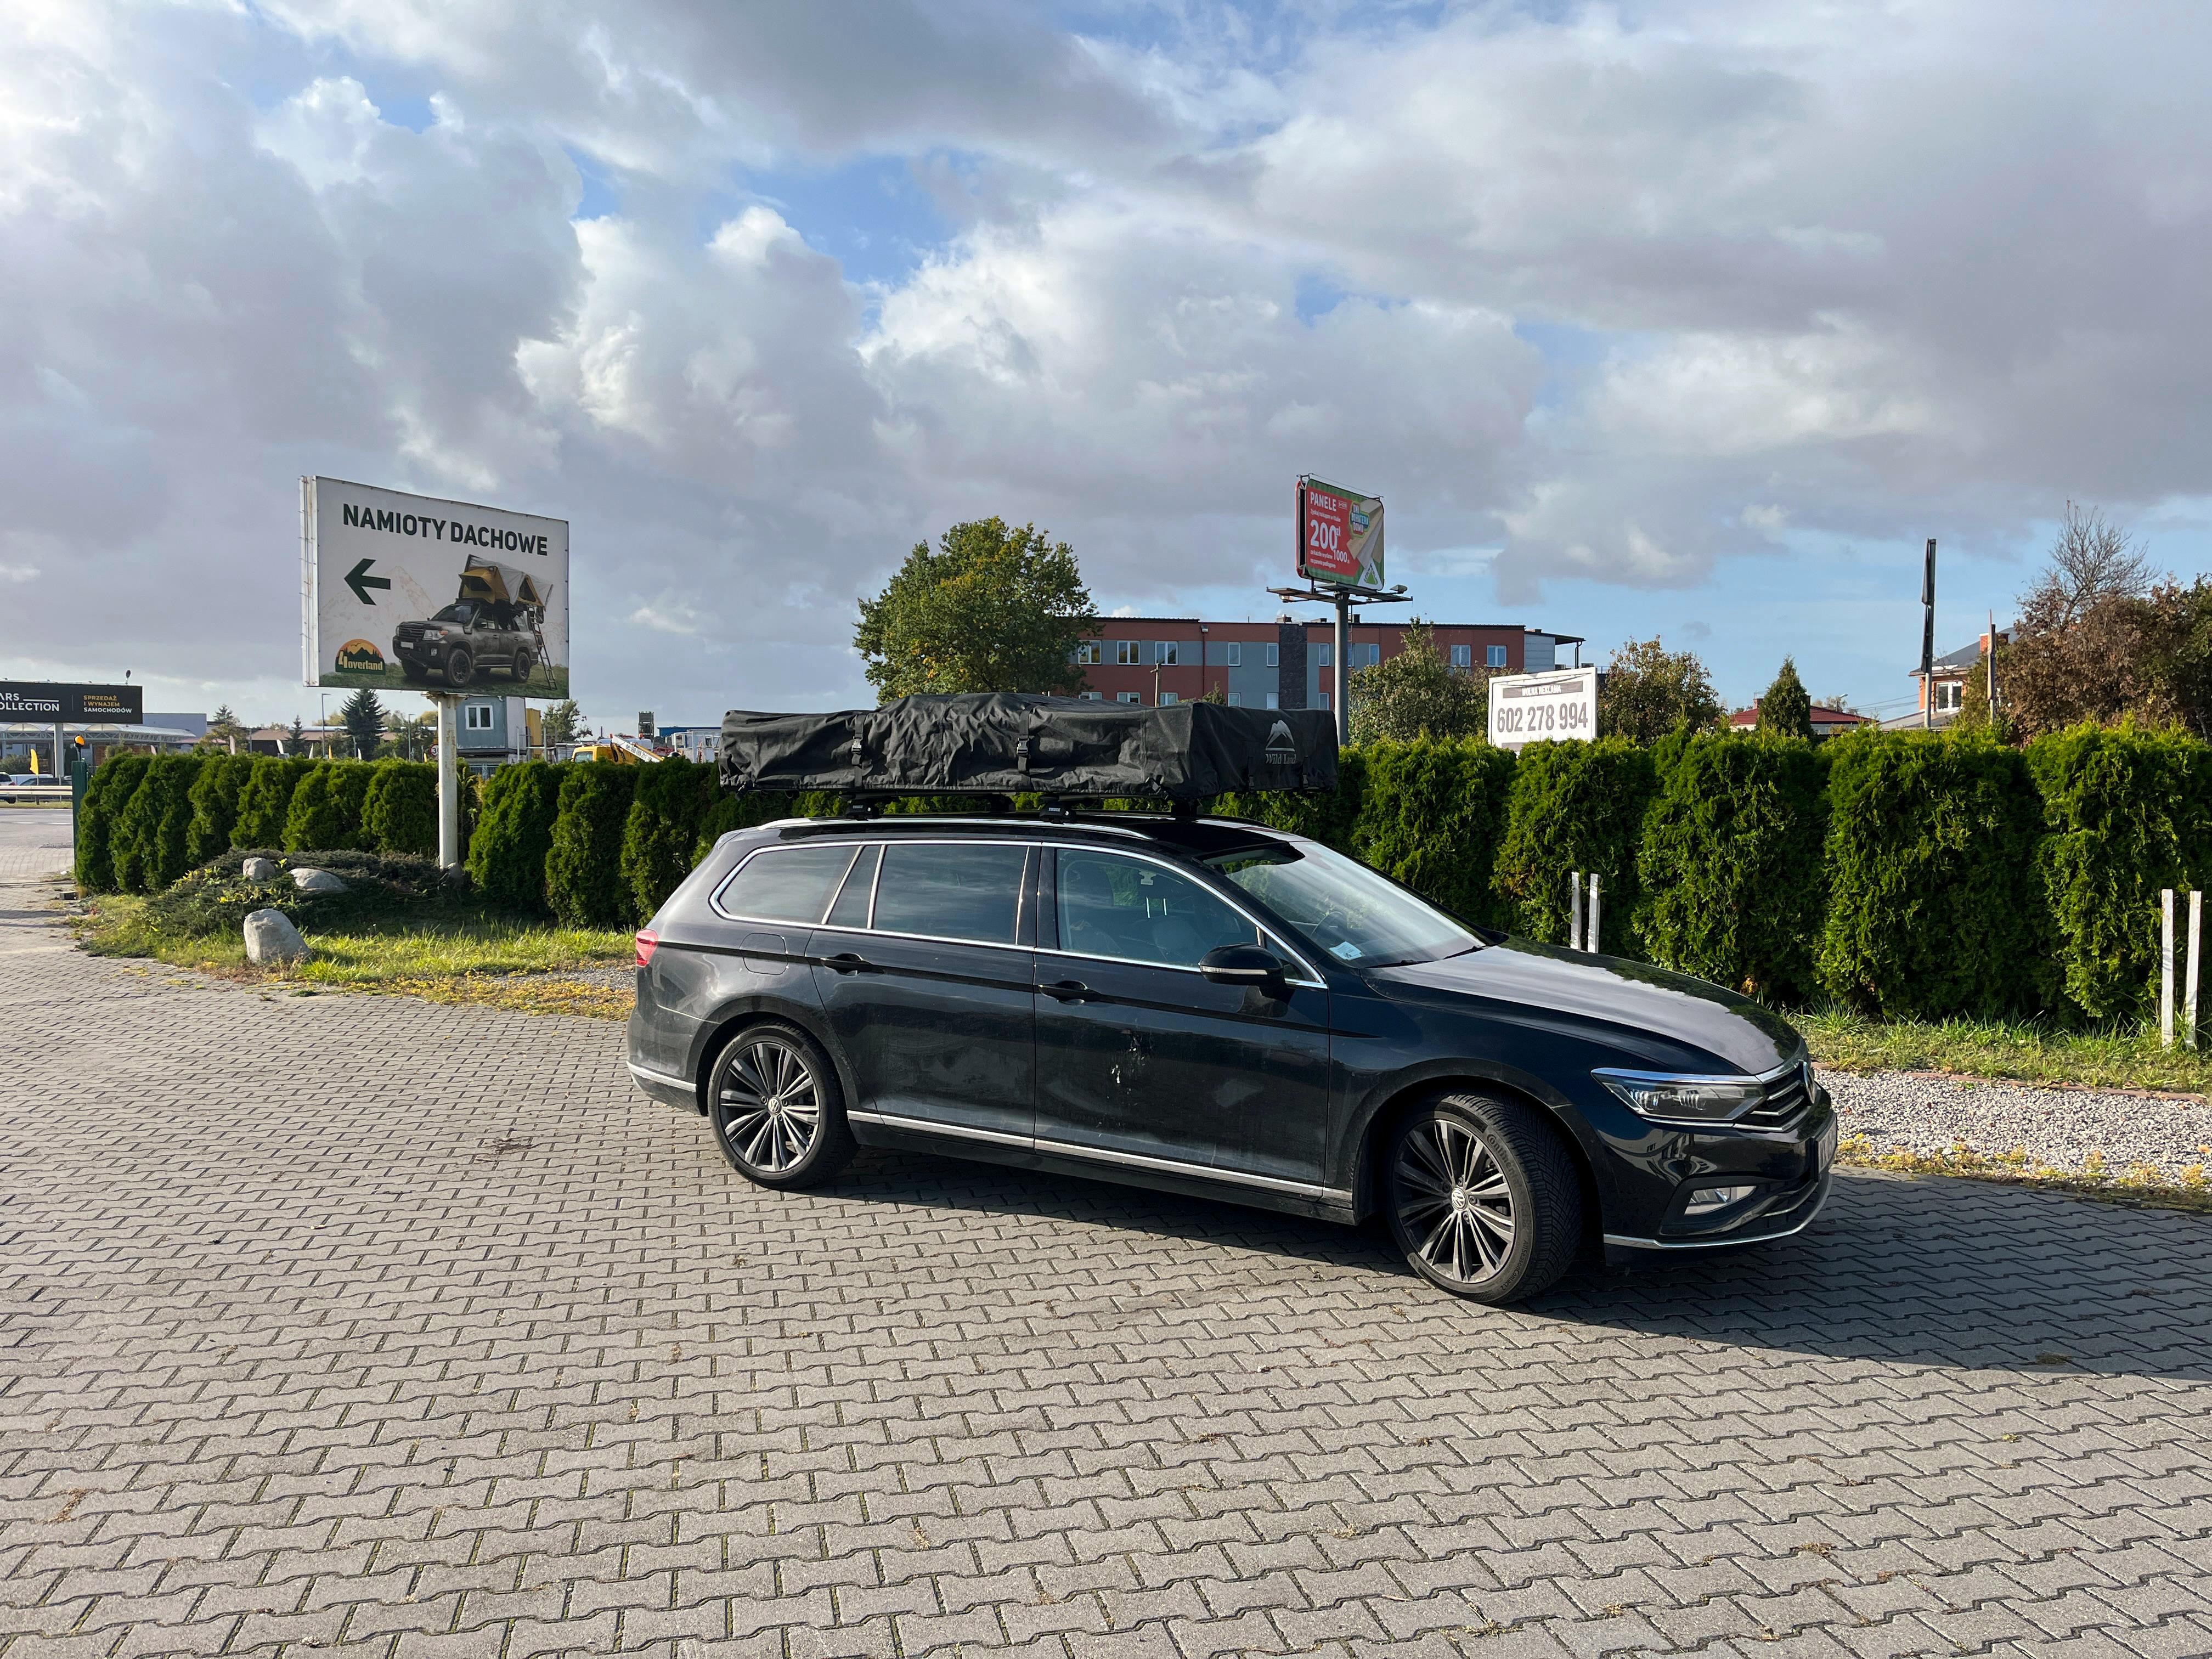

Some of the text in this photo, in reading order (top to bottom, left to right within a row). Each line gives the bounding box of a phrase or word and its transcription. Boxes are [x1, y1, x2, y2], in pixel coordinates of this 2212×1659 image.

[1310, 491, 1336, 511] PANELE
[343, 503, 548, 556] NAMIOTY DACHOWE
[1310, 520, 1338, 551] 200
[1334, 549, 1347, 562] 1000
[1522, 685, 1561, 696] WOLNA REKLAMA
[1497, 702, 1588, 732] 602 278 994
[1265, 753, 1297, 764] Wild Land
